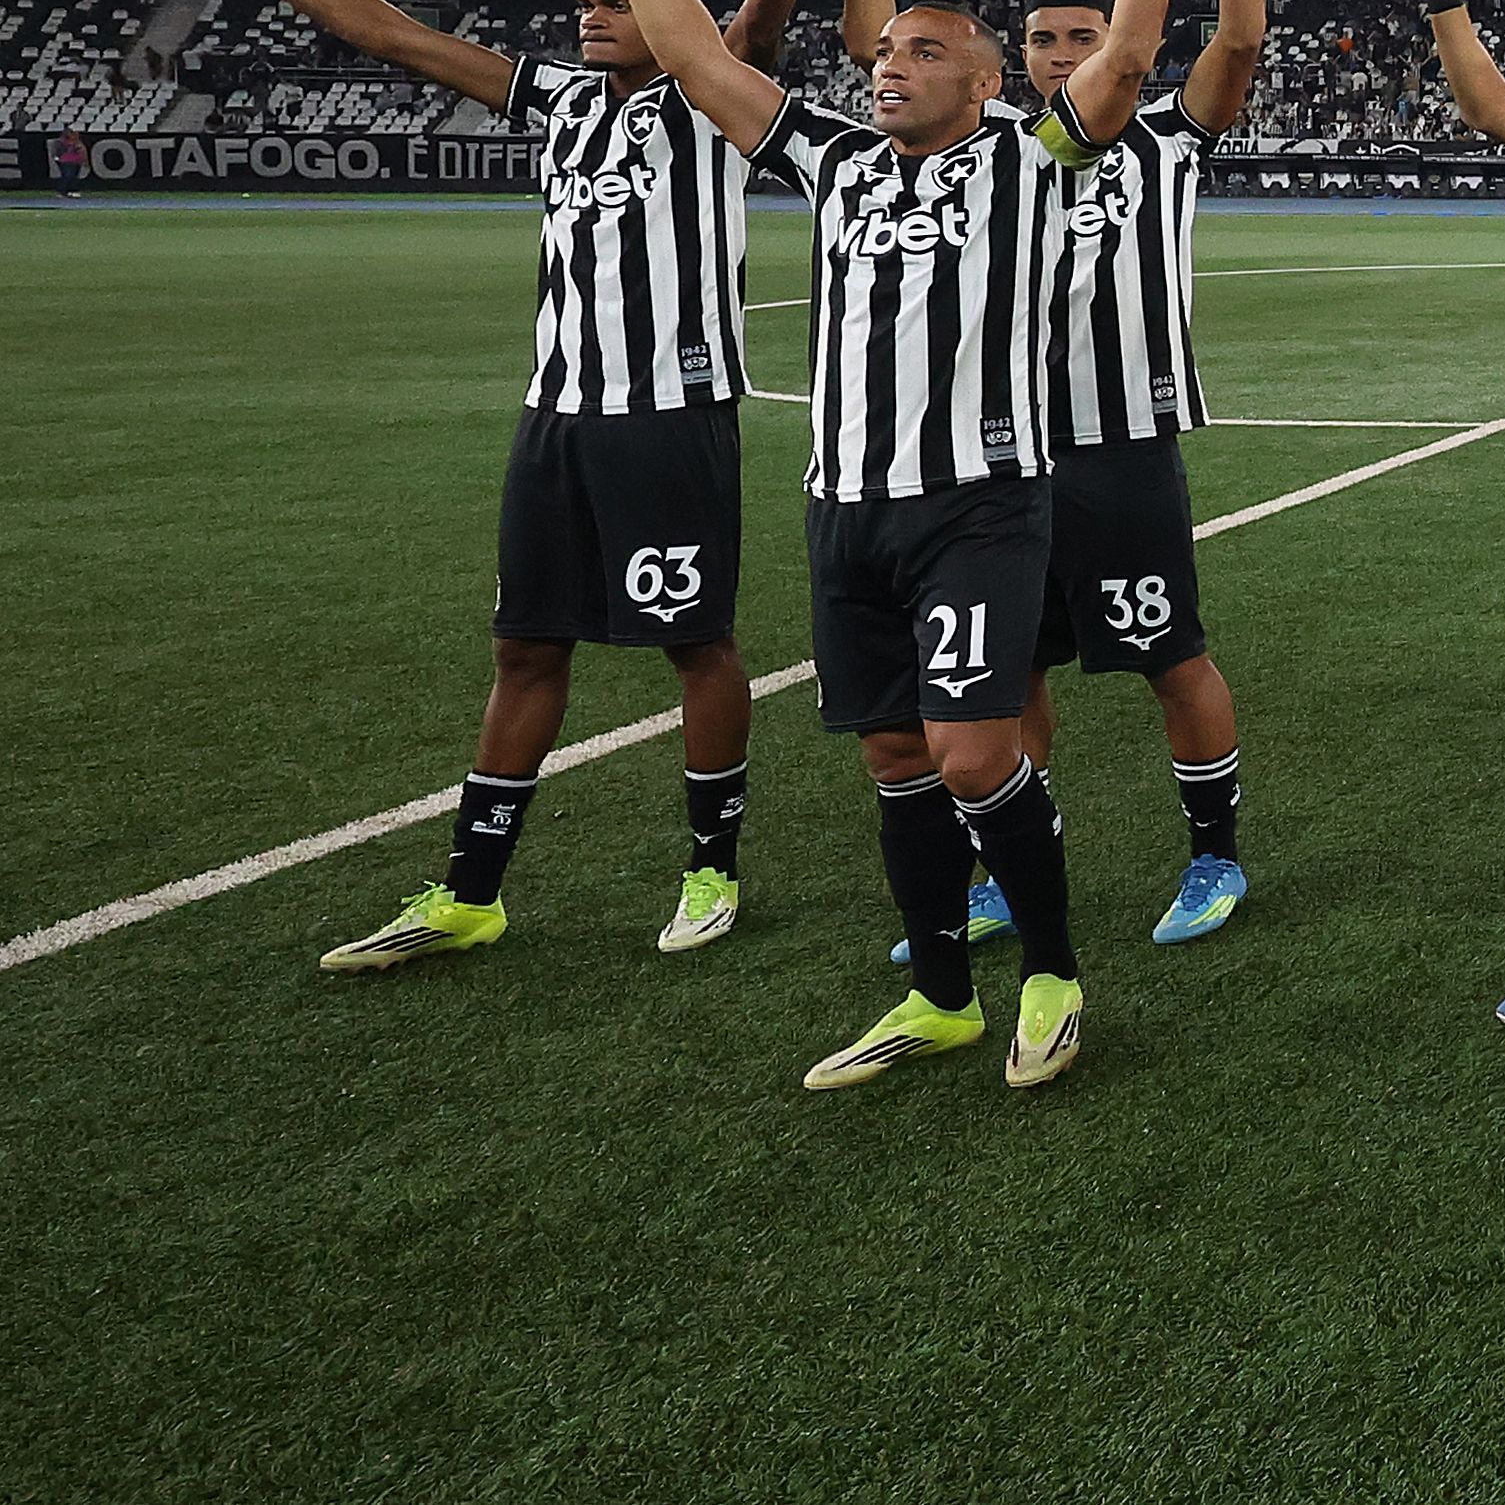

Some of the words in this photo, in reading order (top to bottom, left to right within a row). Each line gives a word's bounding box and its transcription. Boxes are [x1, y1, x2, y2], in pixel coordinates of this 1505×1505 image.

[549, 164, 654, 208] vbet
[838, 201, 968, 255] vbet
[983, 417, 1011, 429] 1942
[625, 545, 701, 603] 63
[1100, 575, 1172, 630] 38
[926, 602, 987, 670] 21
